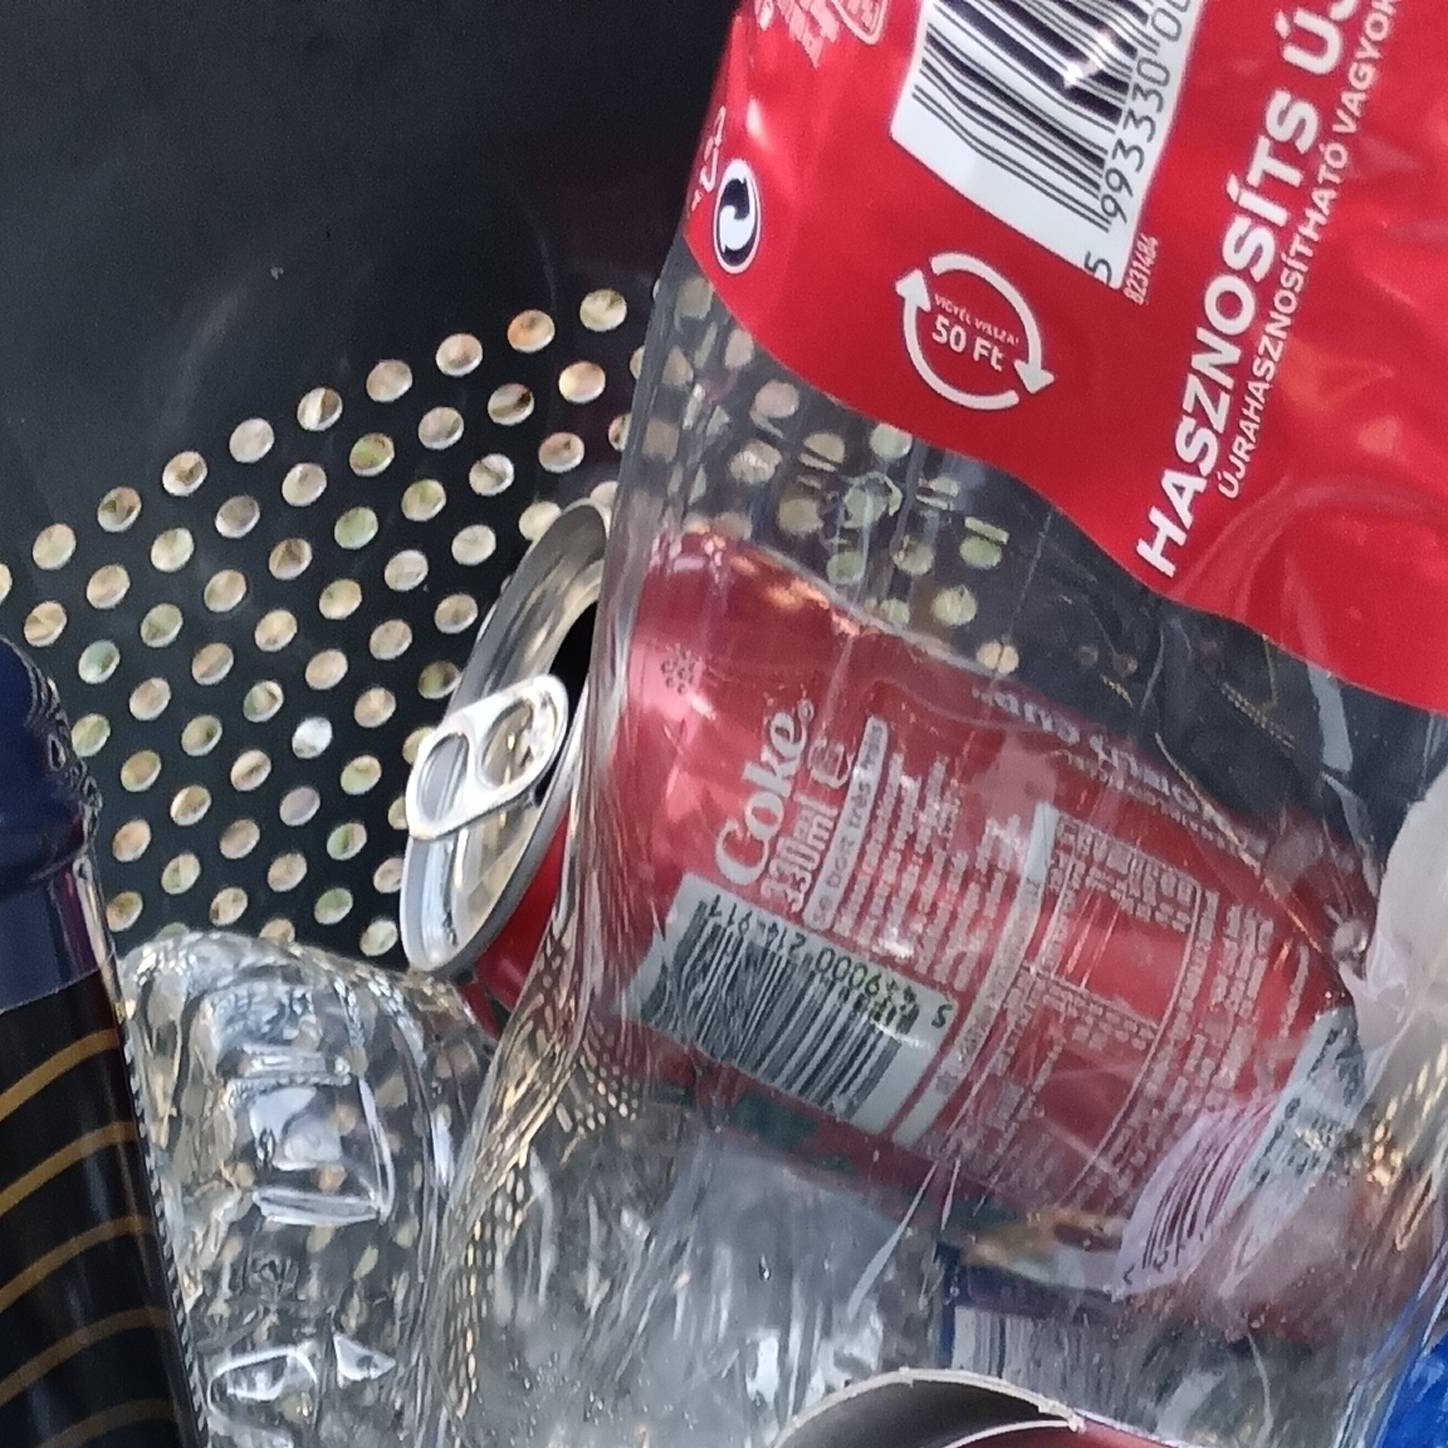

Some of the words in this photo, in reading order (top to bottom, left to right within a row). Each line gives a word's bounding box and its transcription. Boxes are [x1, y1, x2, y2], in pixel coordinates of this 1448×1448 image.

[932, 313, 966, 353] 50
[973, 336, 1004, 372] Ft
[1084, 250, 1112, 286] 5
[1136, 87, 1319, 578] HASZNOSÍTS
[1219, 142, 1349, 500] ÚJRAHASZNOSÍTHATÓ
[715, 711, 806, 885] Coke
